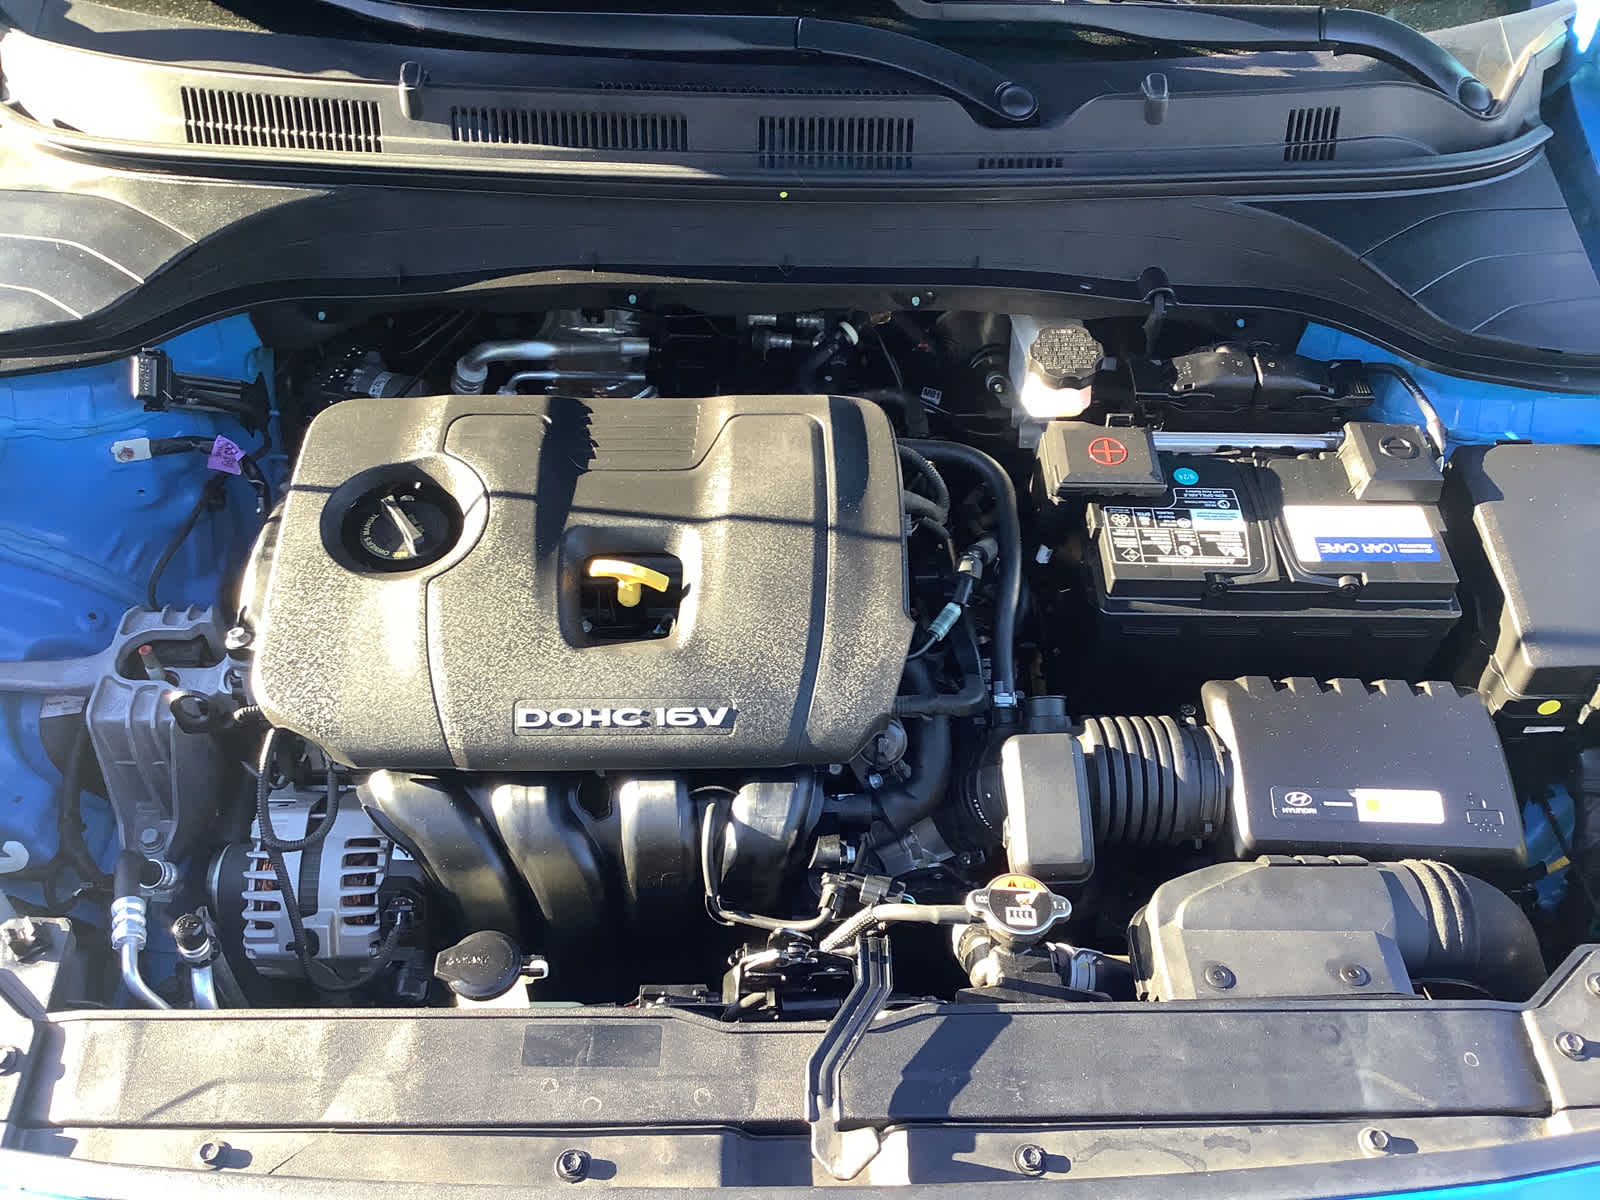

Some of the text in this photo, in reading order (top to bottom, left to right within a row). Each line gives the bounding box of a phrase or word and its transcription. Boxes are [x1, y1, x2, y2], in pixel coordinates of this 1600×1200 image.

[1318, 542, 1360, 554] CARE
[1361, 542, 1394, 554] CAR
[516, 707, 730, 728] DOHC 16V
[1281, 807, 1318, 815] HYUNDAI
